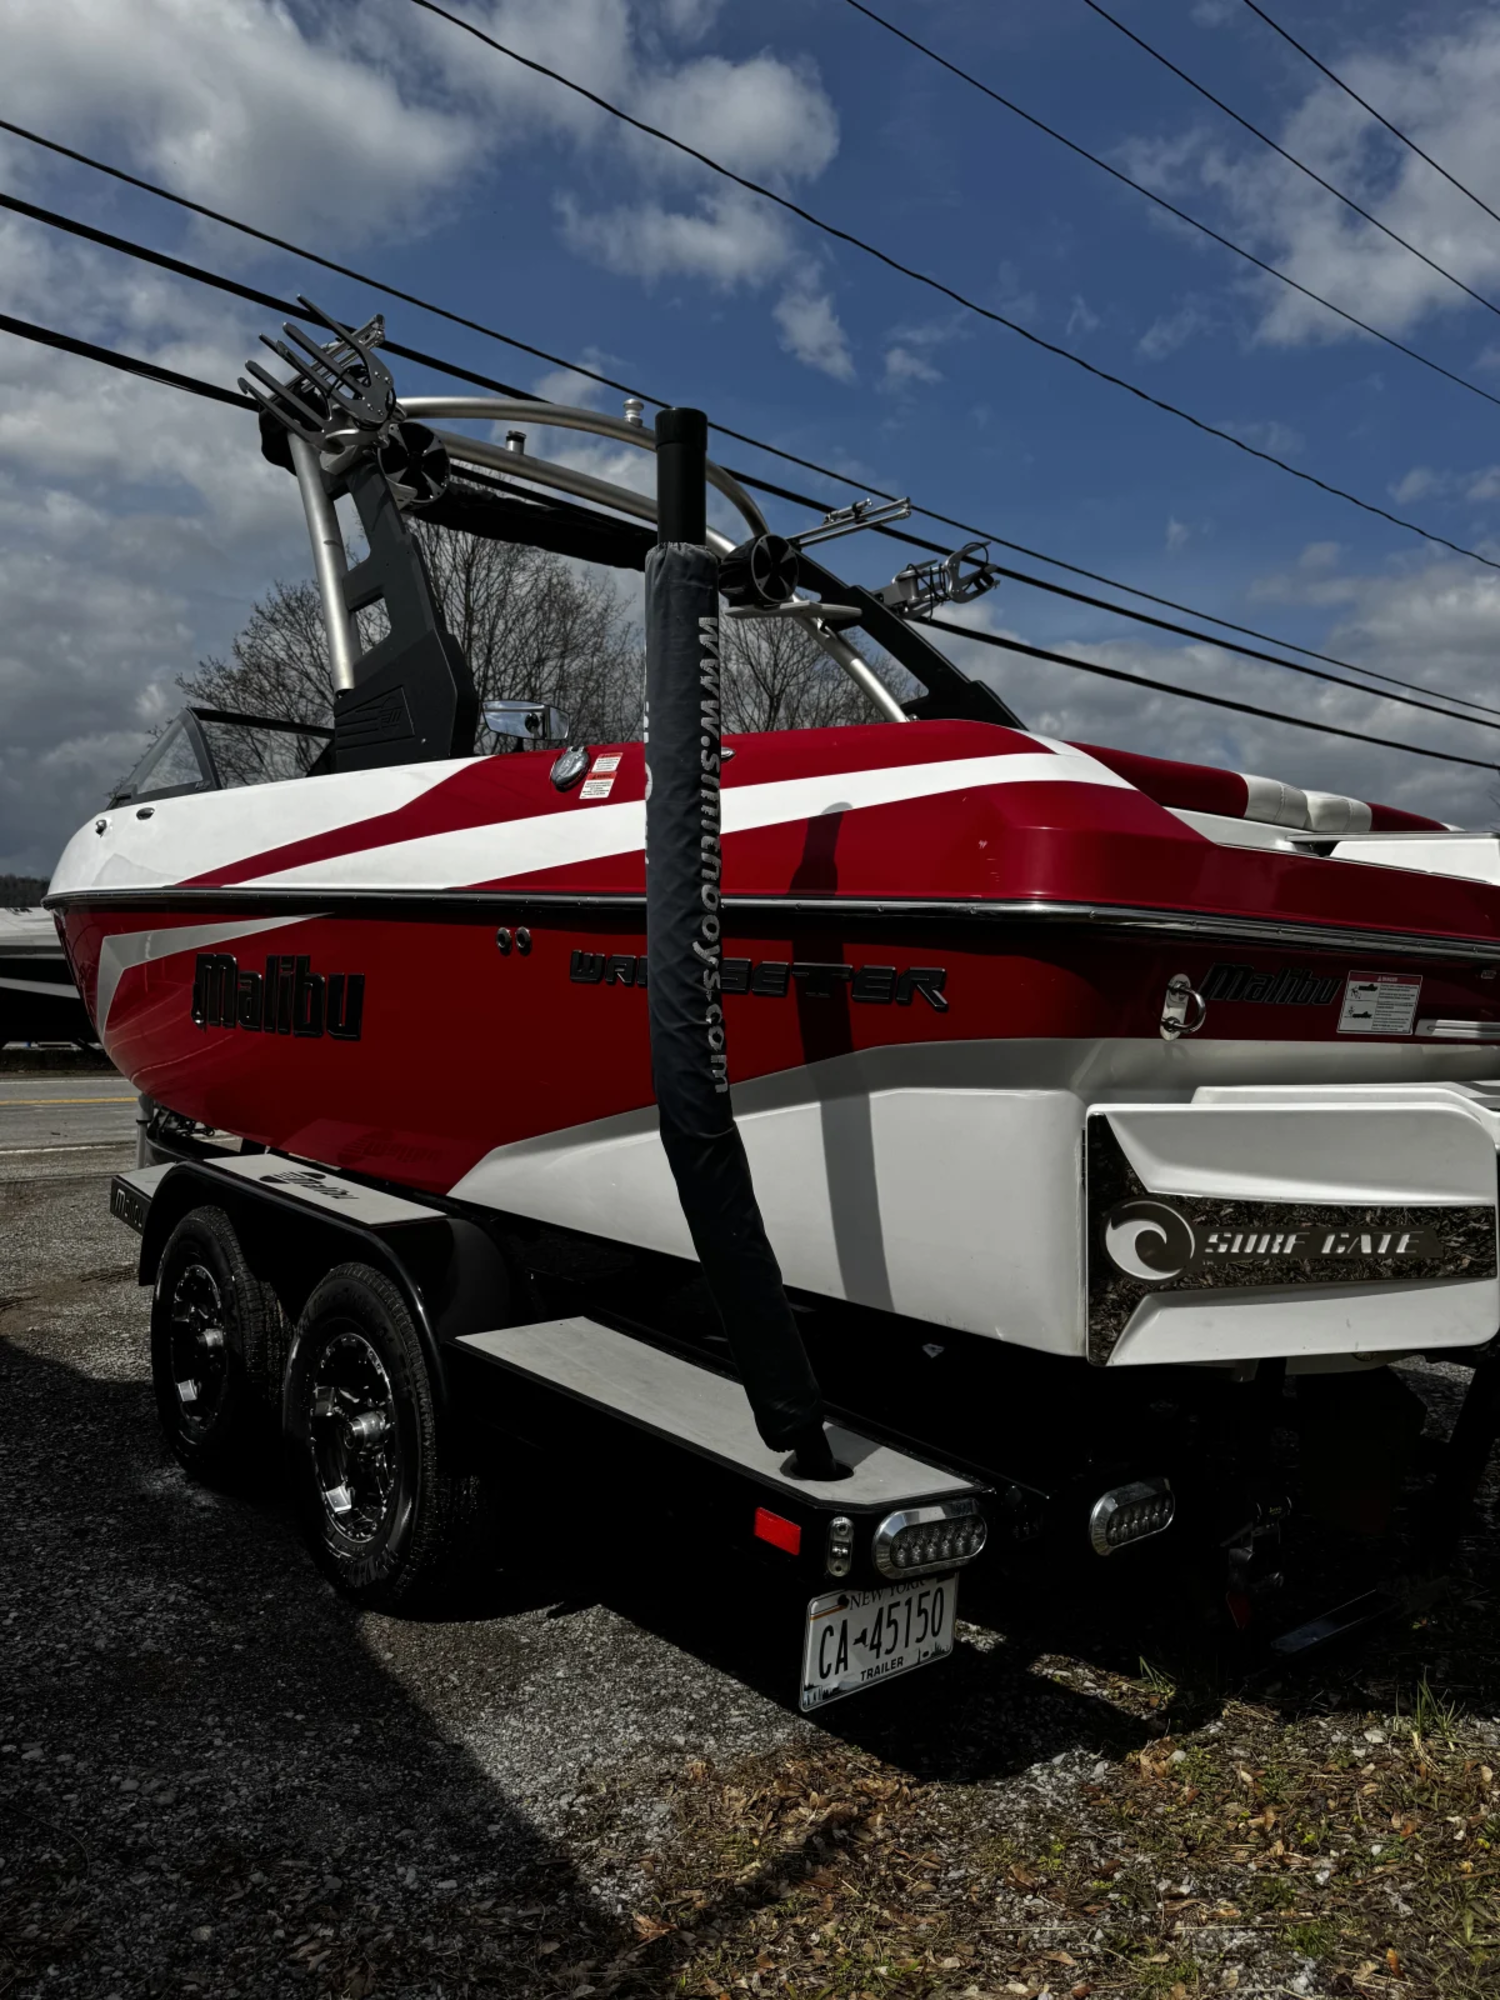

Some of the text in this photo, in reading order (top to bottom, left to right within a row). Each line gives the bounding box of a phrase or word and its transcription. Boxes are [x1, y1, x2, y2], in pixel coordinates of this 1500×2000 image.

[191, 952, 365, 1041] Malibu
[570, 949, 949, 1012] WASETTER
[1199, 962, 1344, 1006] Malibu
[1205, 1230, 1425, 1254] SURF GATE
[819, 1587, 944, 1680] CA 45150
[860, 1656, 904, 1682] TRAILER
